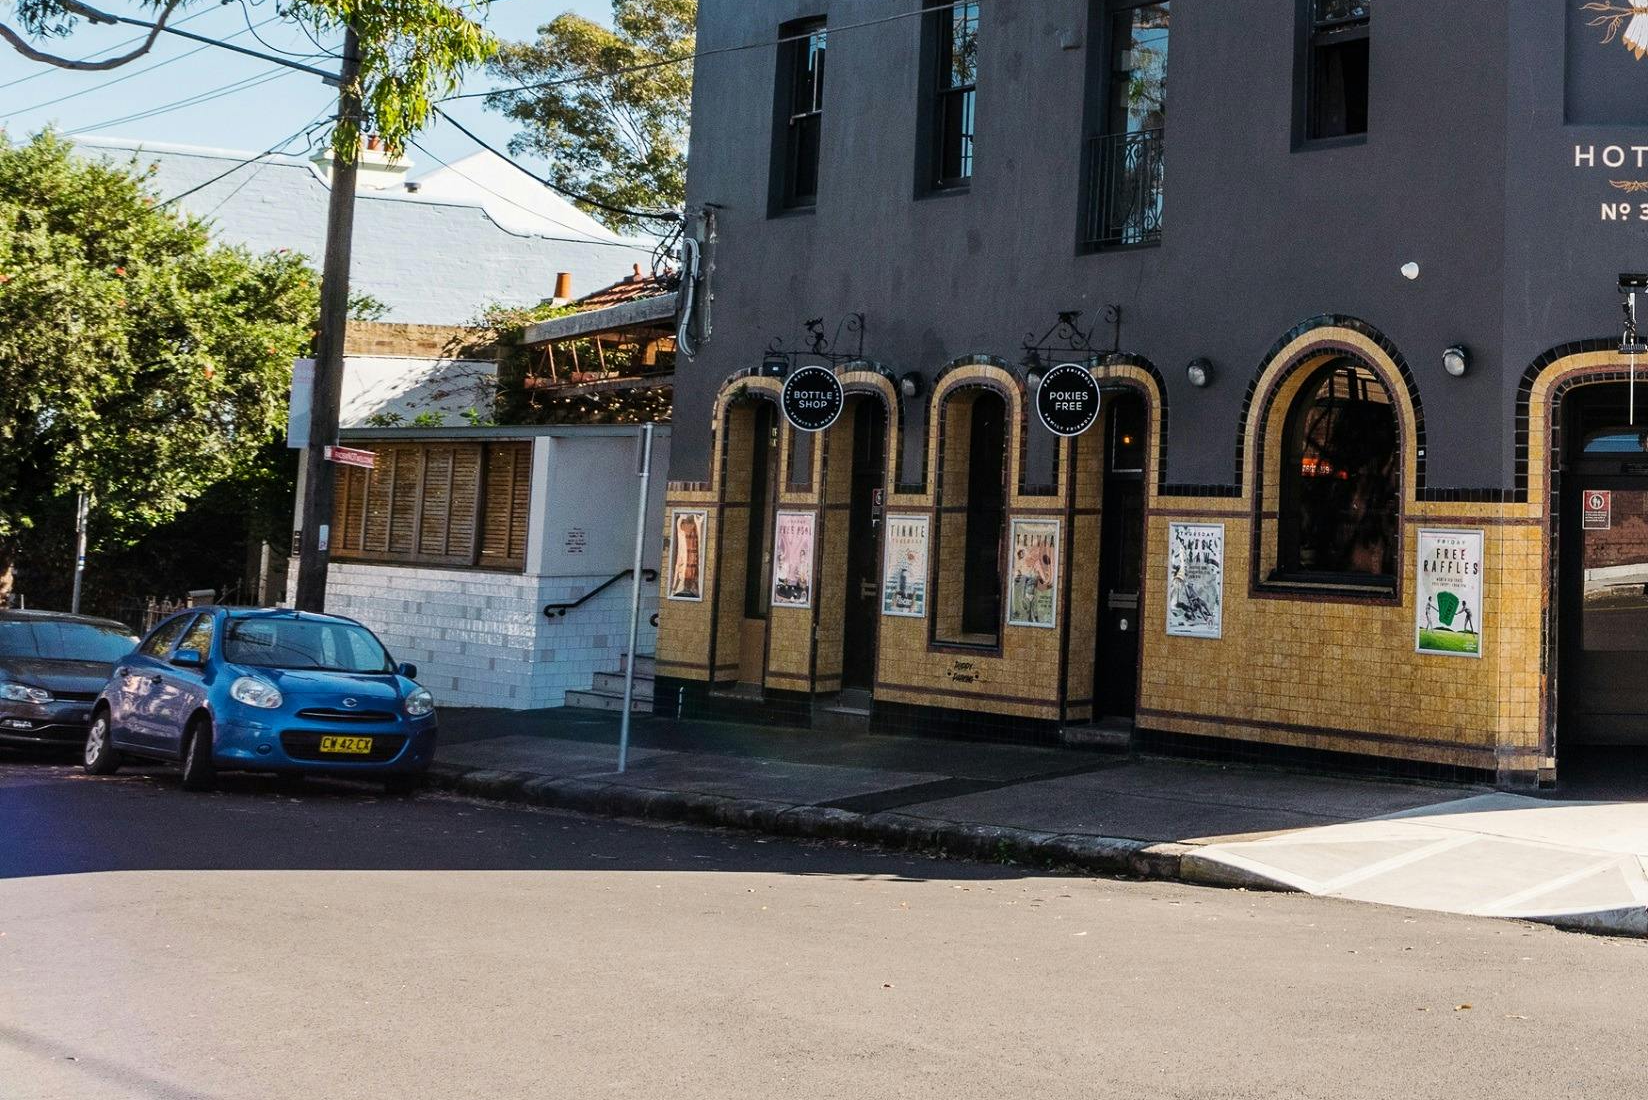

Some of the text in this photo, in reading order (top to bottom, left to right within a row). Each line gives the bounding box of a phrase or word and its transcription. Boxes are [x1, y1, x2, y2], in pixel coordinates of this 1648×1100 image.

[1067, 368, 1093, 386] FRIENDLY
[794, 391, 833, 400] BOTTLE
[1049, 391, 1089, 400] POKIES
[799, 400, 828, 408] SHOP
[1055, 402, 1083, 411] FREE
[1016, 534, 1055, 548] TRIVIA
[1436, 548, 1466, 560] FREE
[1423, 560, 1479, 575] RAFFLES
